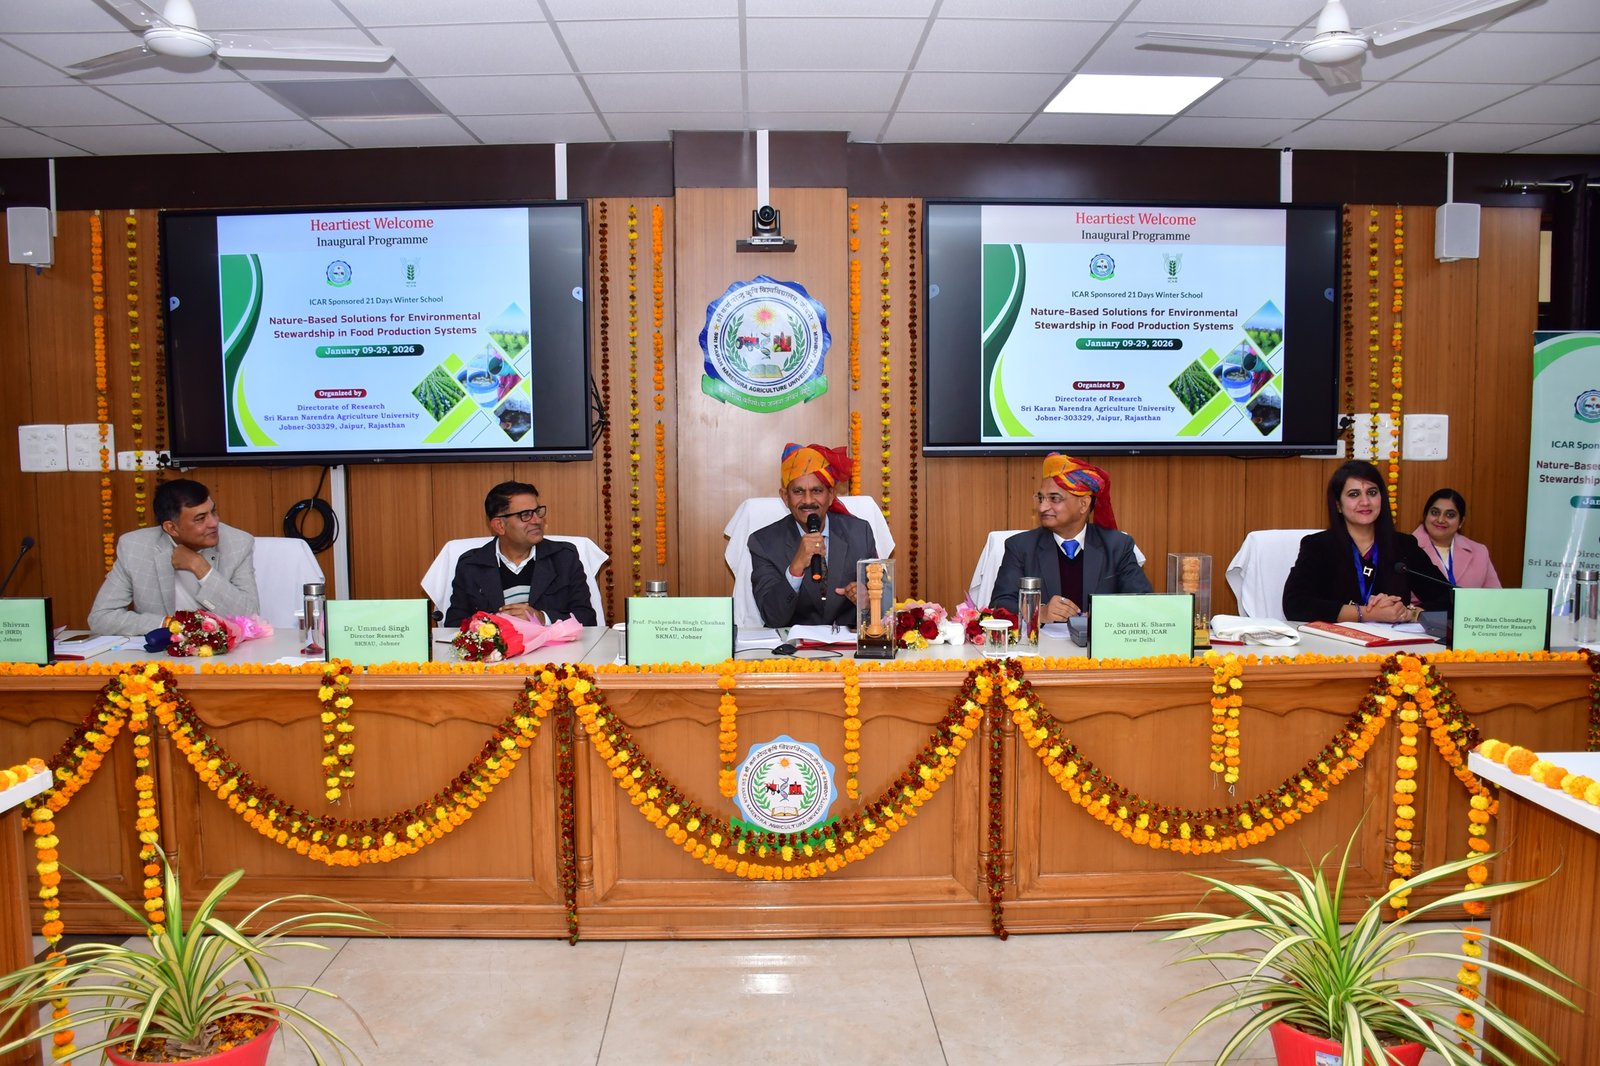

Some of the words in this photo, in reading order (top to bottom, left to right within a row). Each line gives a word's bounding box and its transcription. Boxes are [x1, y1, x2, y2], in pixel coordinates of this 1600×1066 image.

[311, 219, 370, 231] Heartiest
[374, 217, 434, 229] Welcome
[1076, 212, 1135, 225] Heartiest
[1139, 213, 1196, 225] Welcome
[1081, 230, 1129, 242] Inaugural
[1132, 231, 1190, 242] Programme
[317, 236, 365, 248] Inaugural
[368, 236, 428, 247] Programme
[329, 298, 364, 306] Sponsored
[269, 315, 337, 324] Nature-Based
[341, 314, 387, 323] Solutions
[390, 313, 405, 322] for
[408, 312, 480, 321] Environmental
[1030, 308, 1099, 316] Nature-Based
[1102, 308, 1147, 316] Solutions
[1151, 308, 1165, 316] for
[1169, 308, 1238, 317] Environmental
[1034, 321, 1096, 331] Stewardship
[1138, 322, 1190, 330] Production
[1193, 322, 1234, 332] Systems
[274, 329, 335, 339] Stewardship
[350, 328, 374, 336] Food
[377, 327, 431, 336] Production
[434, 326, 477, 336] Systems
[1085, 340, 1120, 348] January
[1122, 340, 1150, 348] 09-29,
[325, 347, 360, 356] January
[749, 385, 787, 393] AGRICULTURE
[1577, 441, 1600, 450] Spon
